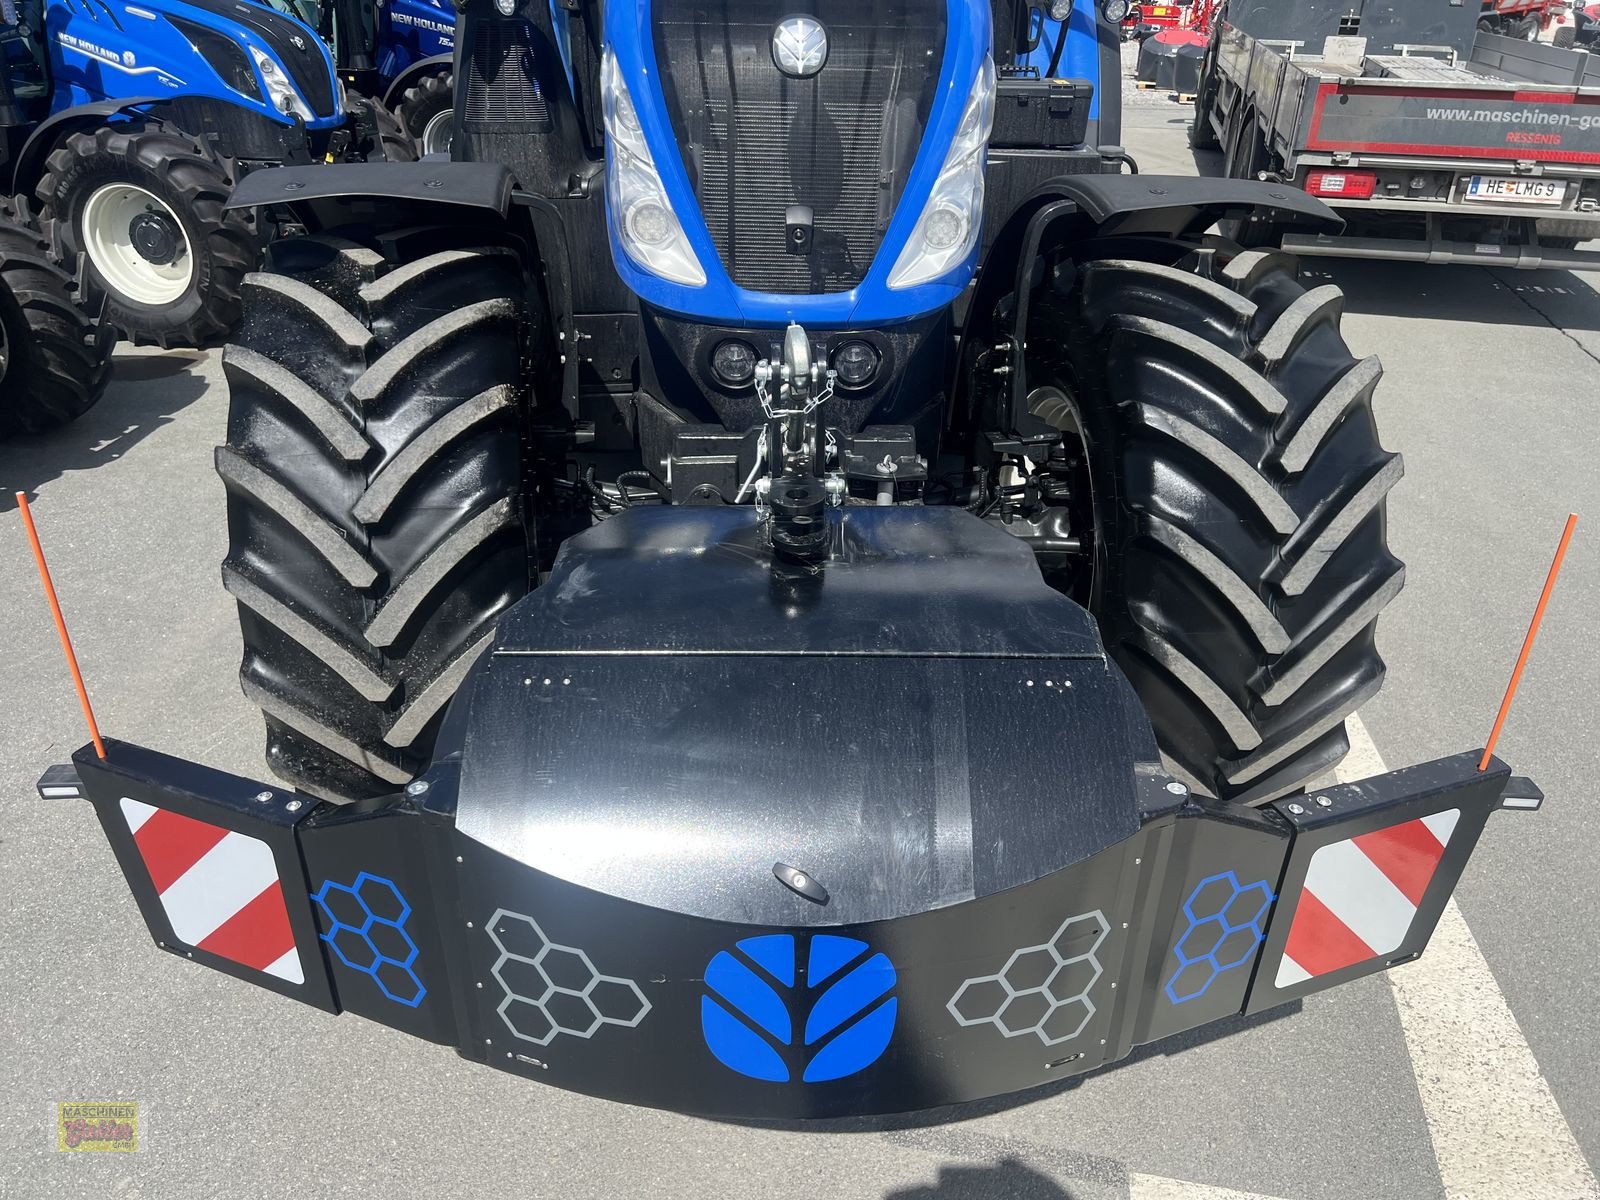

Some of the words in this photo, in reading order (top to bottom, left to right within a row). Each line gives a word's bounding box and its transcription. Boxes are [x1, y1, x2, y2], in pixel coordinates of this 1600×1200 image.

[391, 12, 412, 25] NEW
[57, 31, 77, 46] NEW
[78, 39, 120, 62] HOLLAND
[1504, 131, 1562, 145] RESSENIG
[1486, 179, 1505, 194] HE
[1515, 181, 1543, 196] LMG
[1545, 183, 1555, 197] 9
